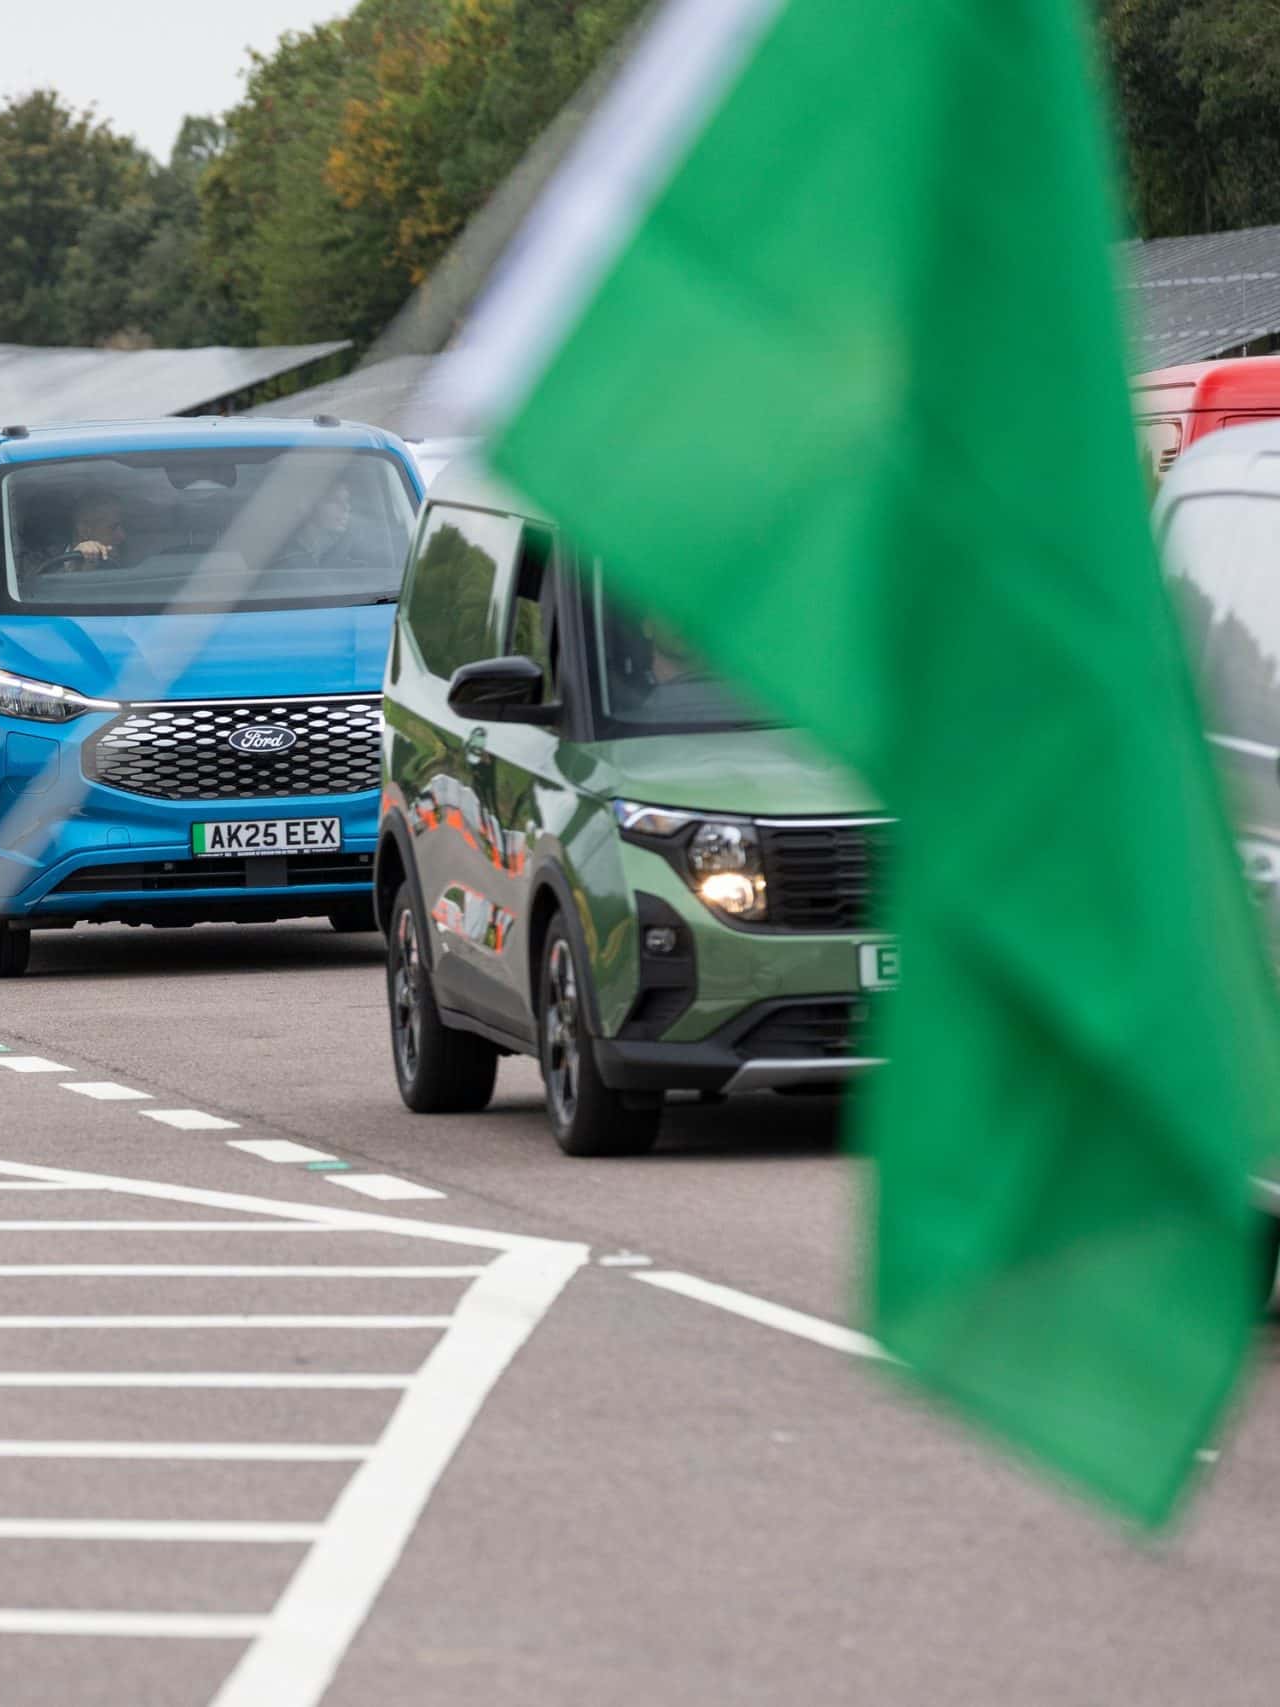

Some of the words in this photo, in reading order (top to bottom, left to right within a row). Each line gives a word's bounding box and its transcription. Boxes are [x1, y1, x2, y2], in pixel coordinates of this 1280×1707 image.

[240, 730, 285, 747] Ford
[210, 823, 278, 849] AK25
[285, 820, 336, 846] EEX
